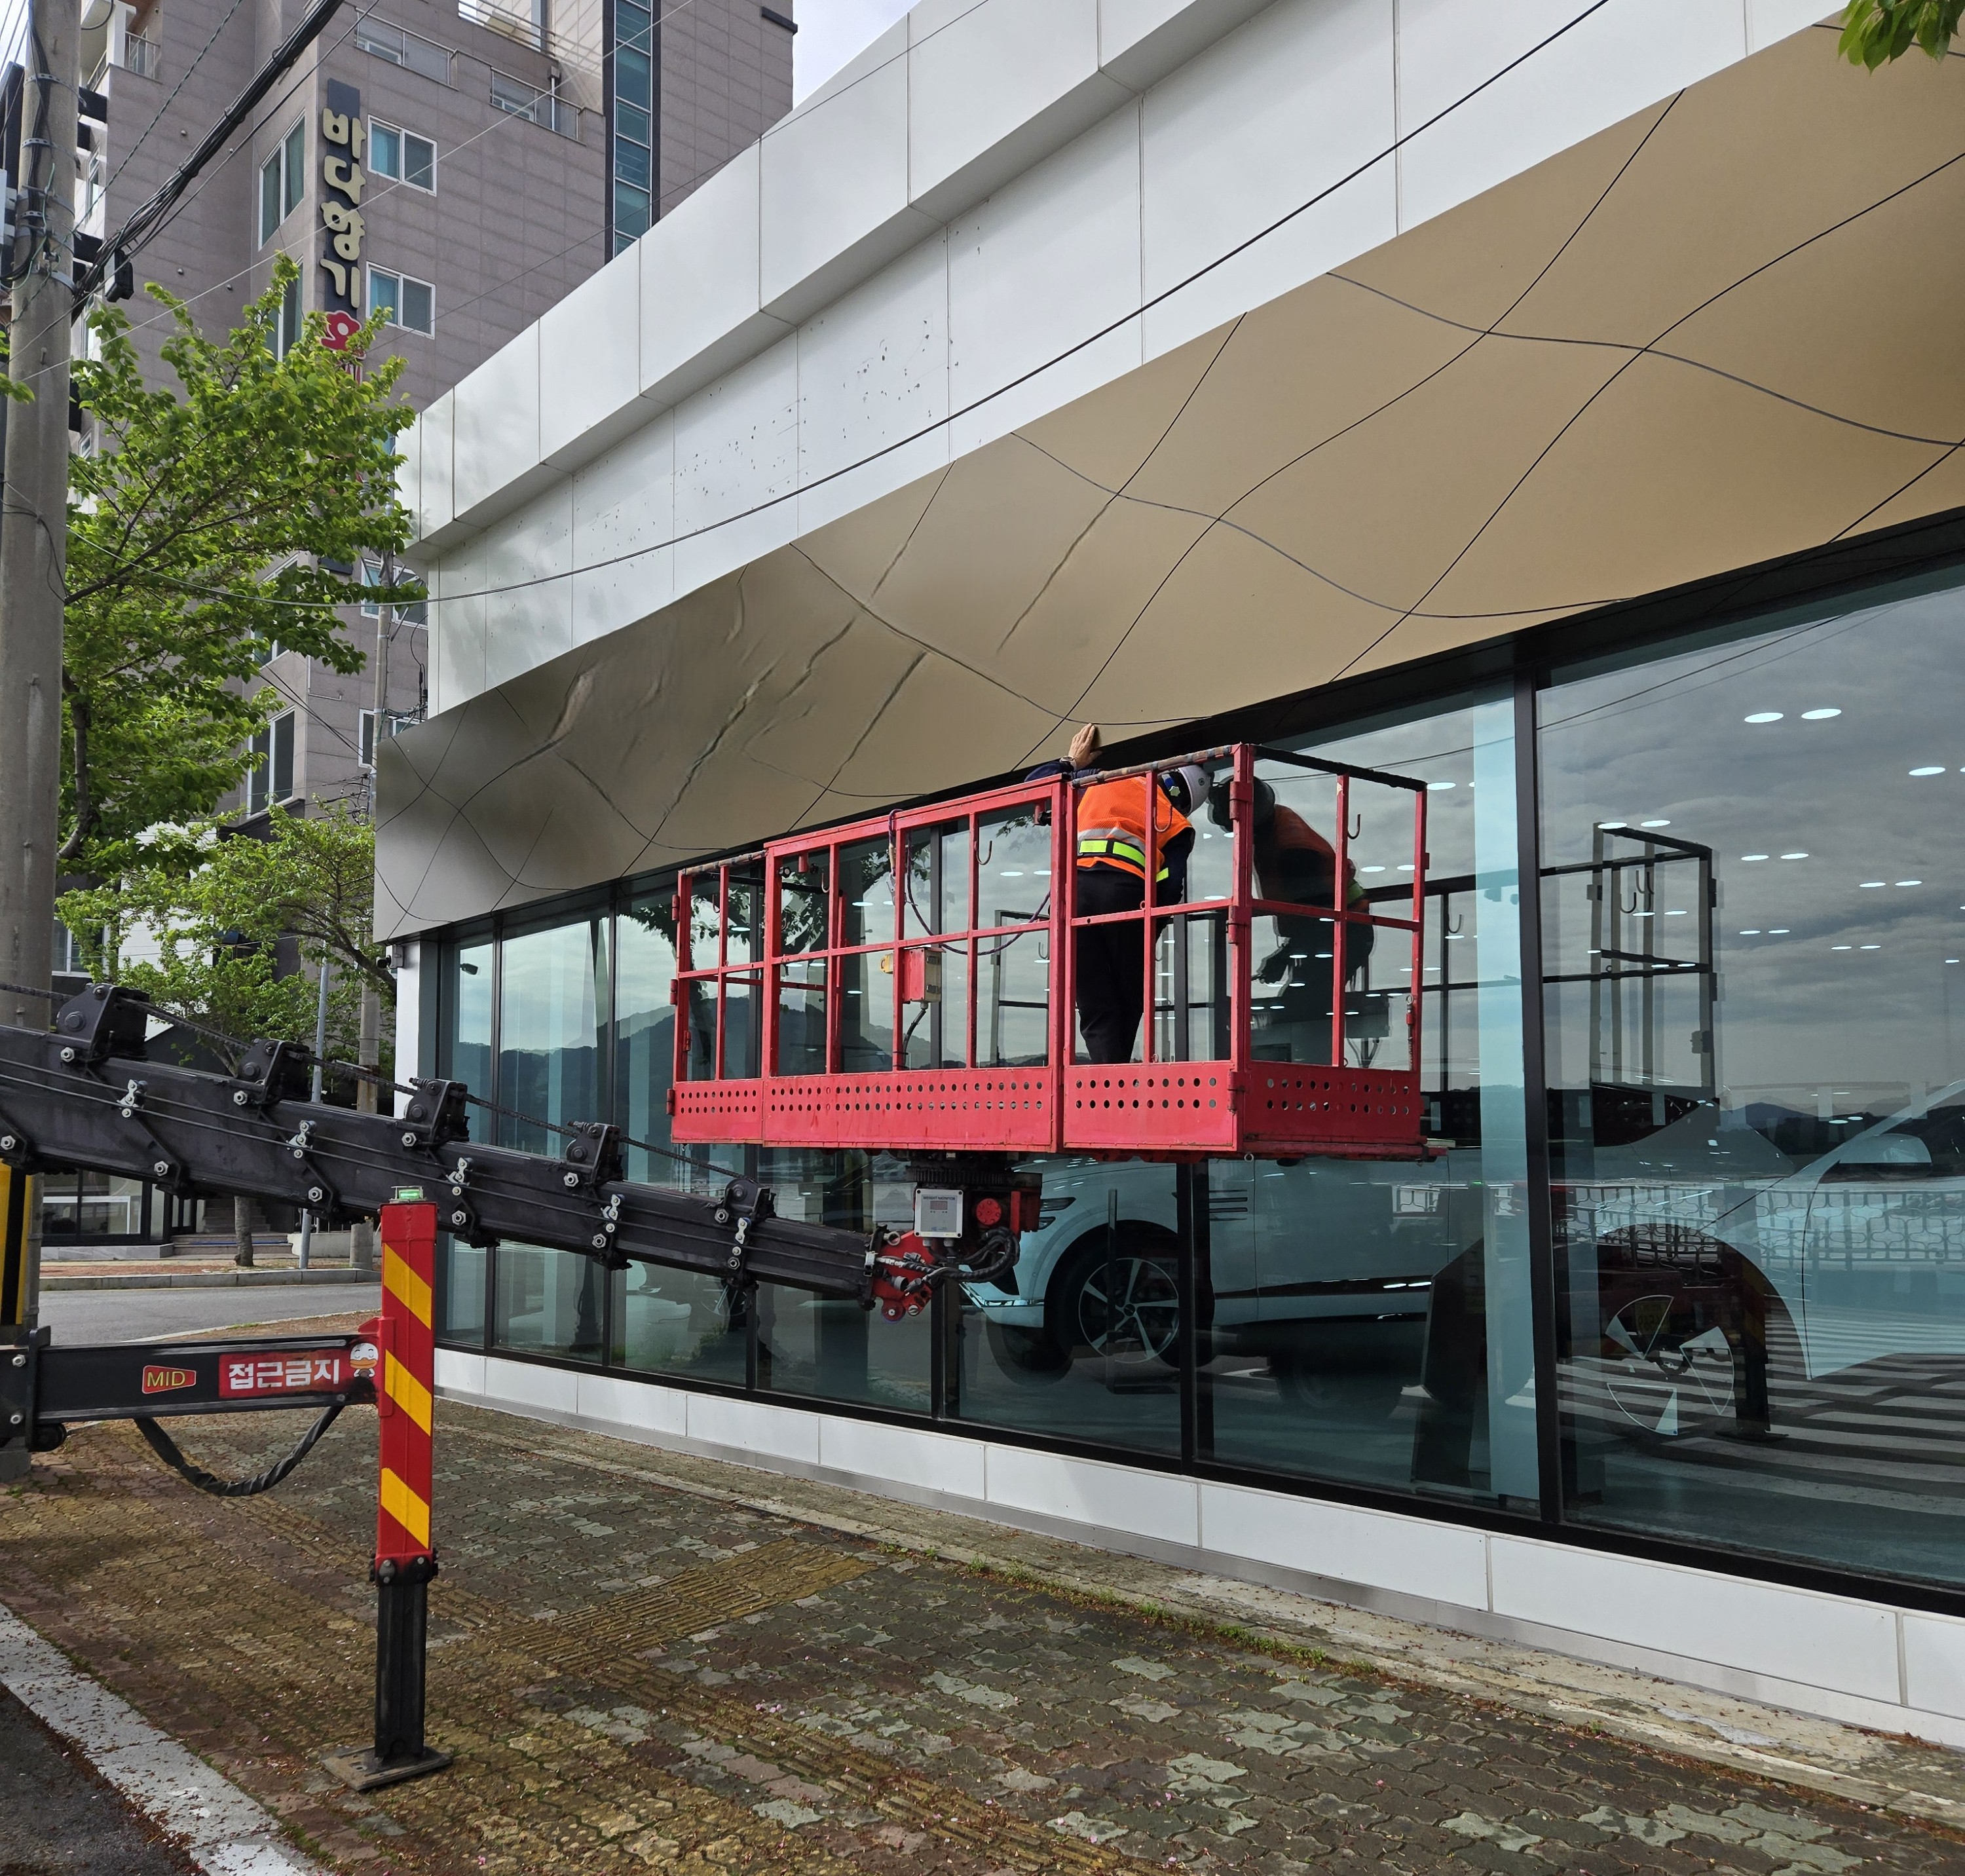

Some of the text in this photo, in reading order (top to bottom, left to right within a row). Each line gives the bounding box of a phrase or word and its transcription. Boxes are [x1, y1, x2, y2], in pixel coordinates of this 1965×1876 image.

[320, 108, 367, 309] 바다향기
[147, 1371, 186, 1387] MID
[229, 1359, 340, 1390] 접근금지
